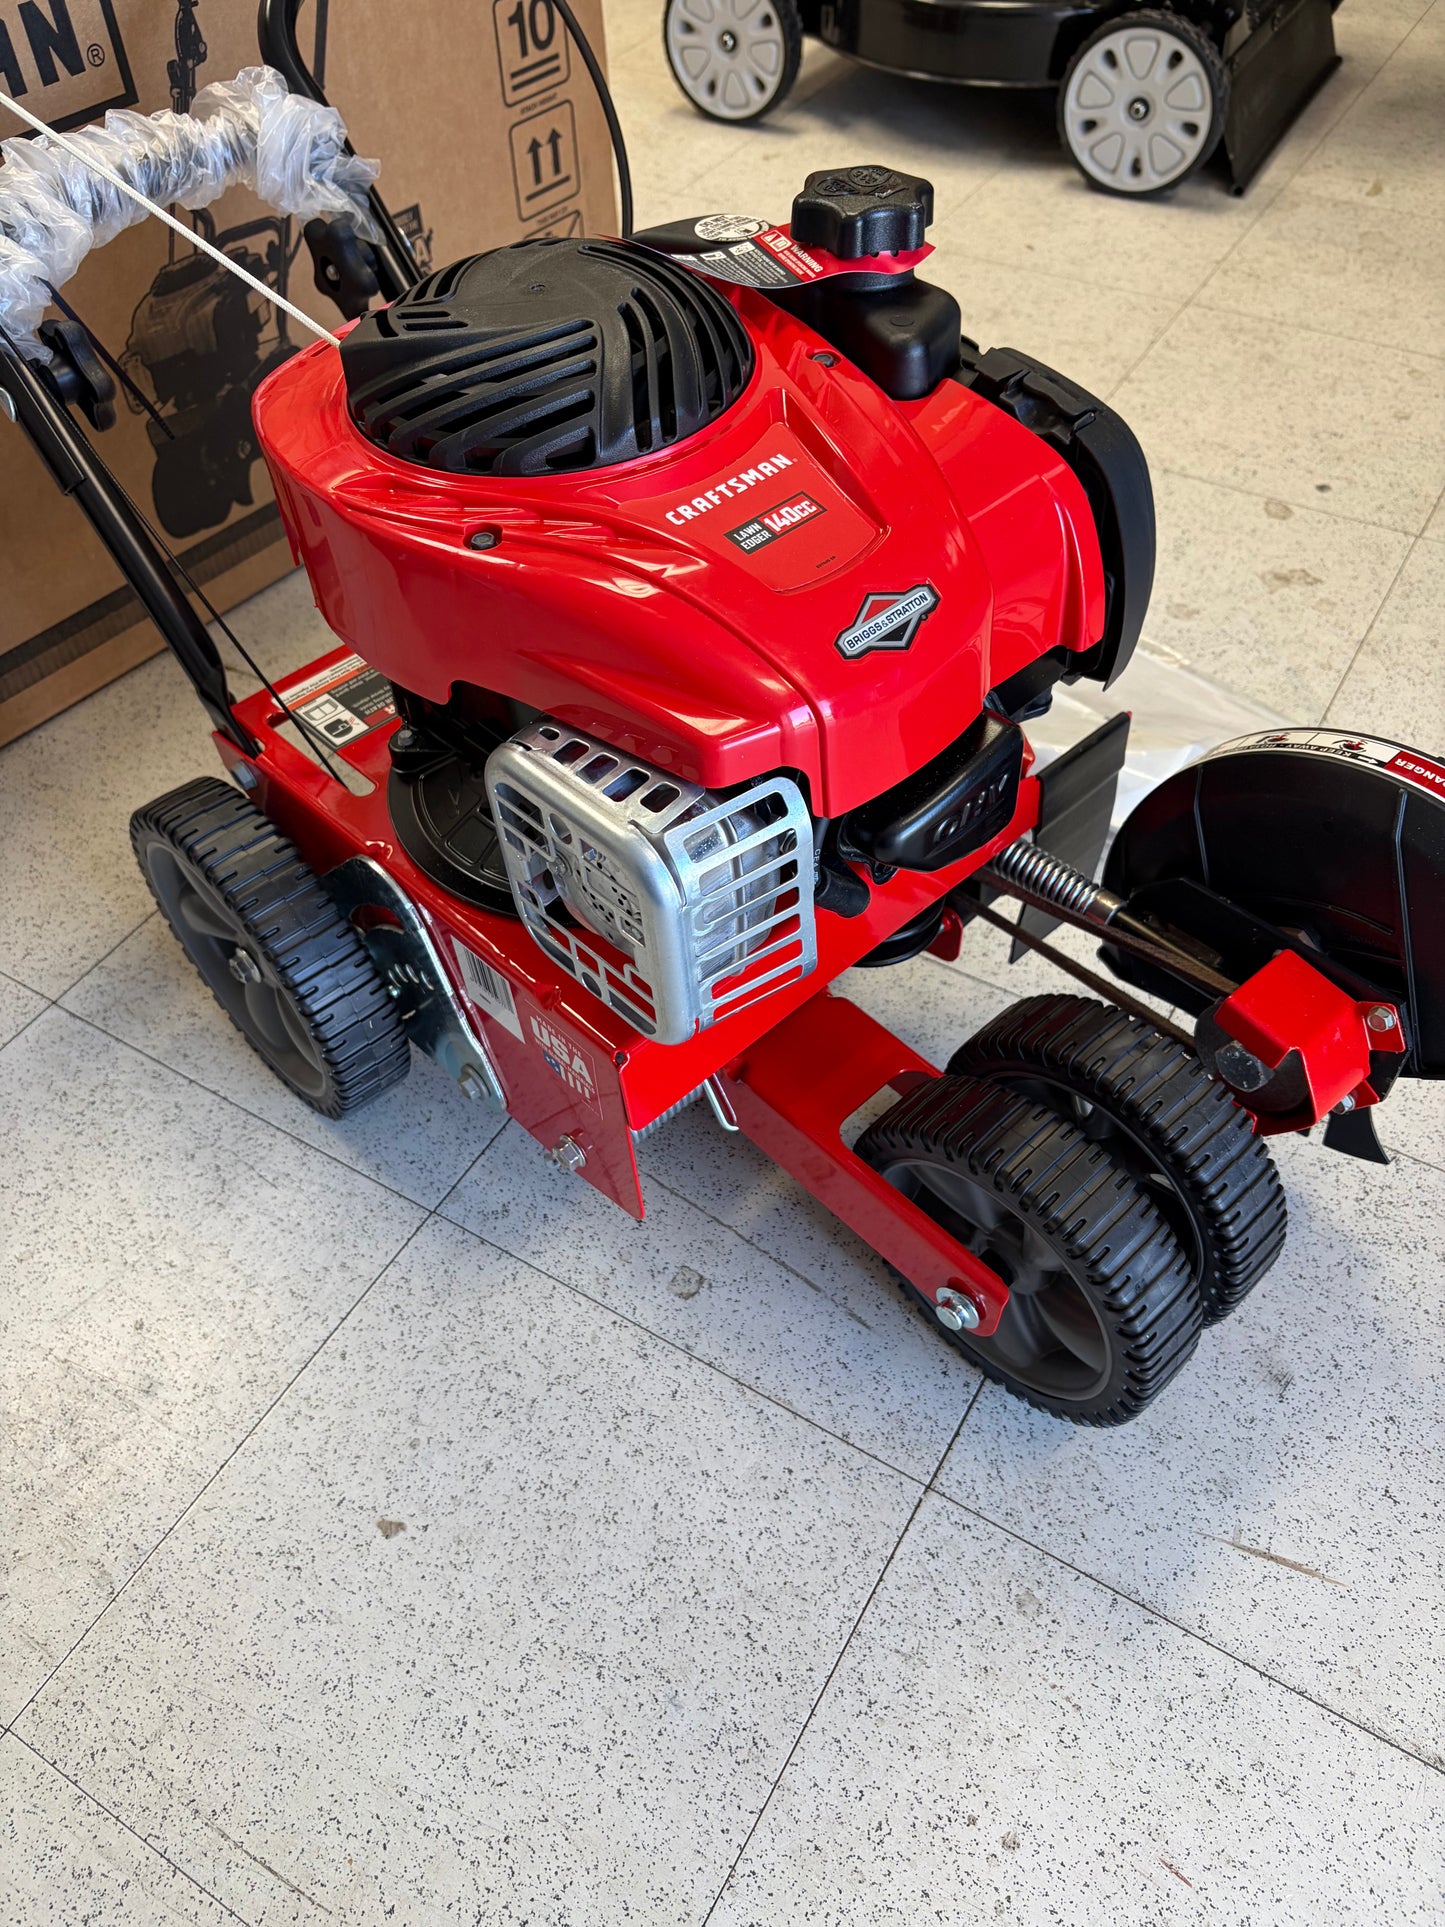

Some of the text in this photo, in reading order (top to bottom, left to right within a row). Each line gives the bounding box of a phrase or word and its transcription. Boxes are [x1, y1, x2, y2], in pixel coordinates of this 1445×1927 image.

[508, 0, 555, 58] 10
[791, 244, 824, 273] WARNING
[665, 453, 794, 526] CRAFTSMAN
[733, 522, 763, 541] LAWN
[740, 530, 772, 550] EDGER
[1285, 744, 1318, 752] AWAY
[1320, 747, 1351, 757] KEEP
[530, 1015, 593, 1086] USA
[536, 1015, 582, 1058] MADE IN THE
